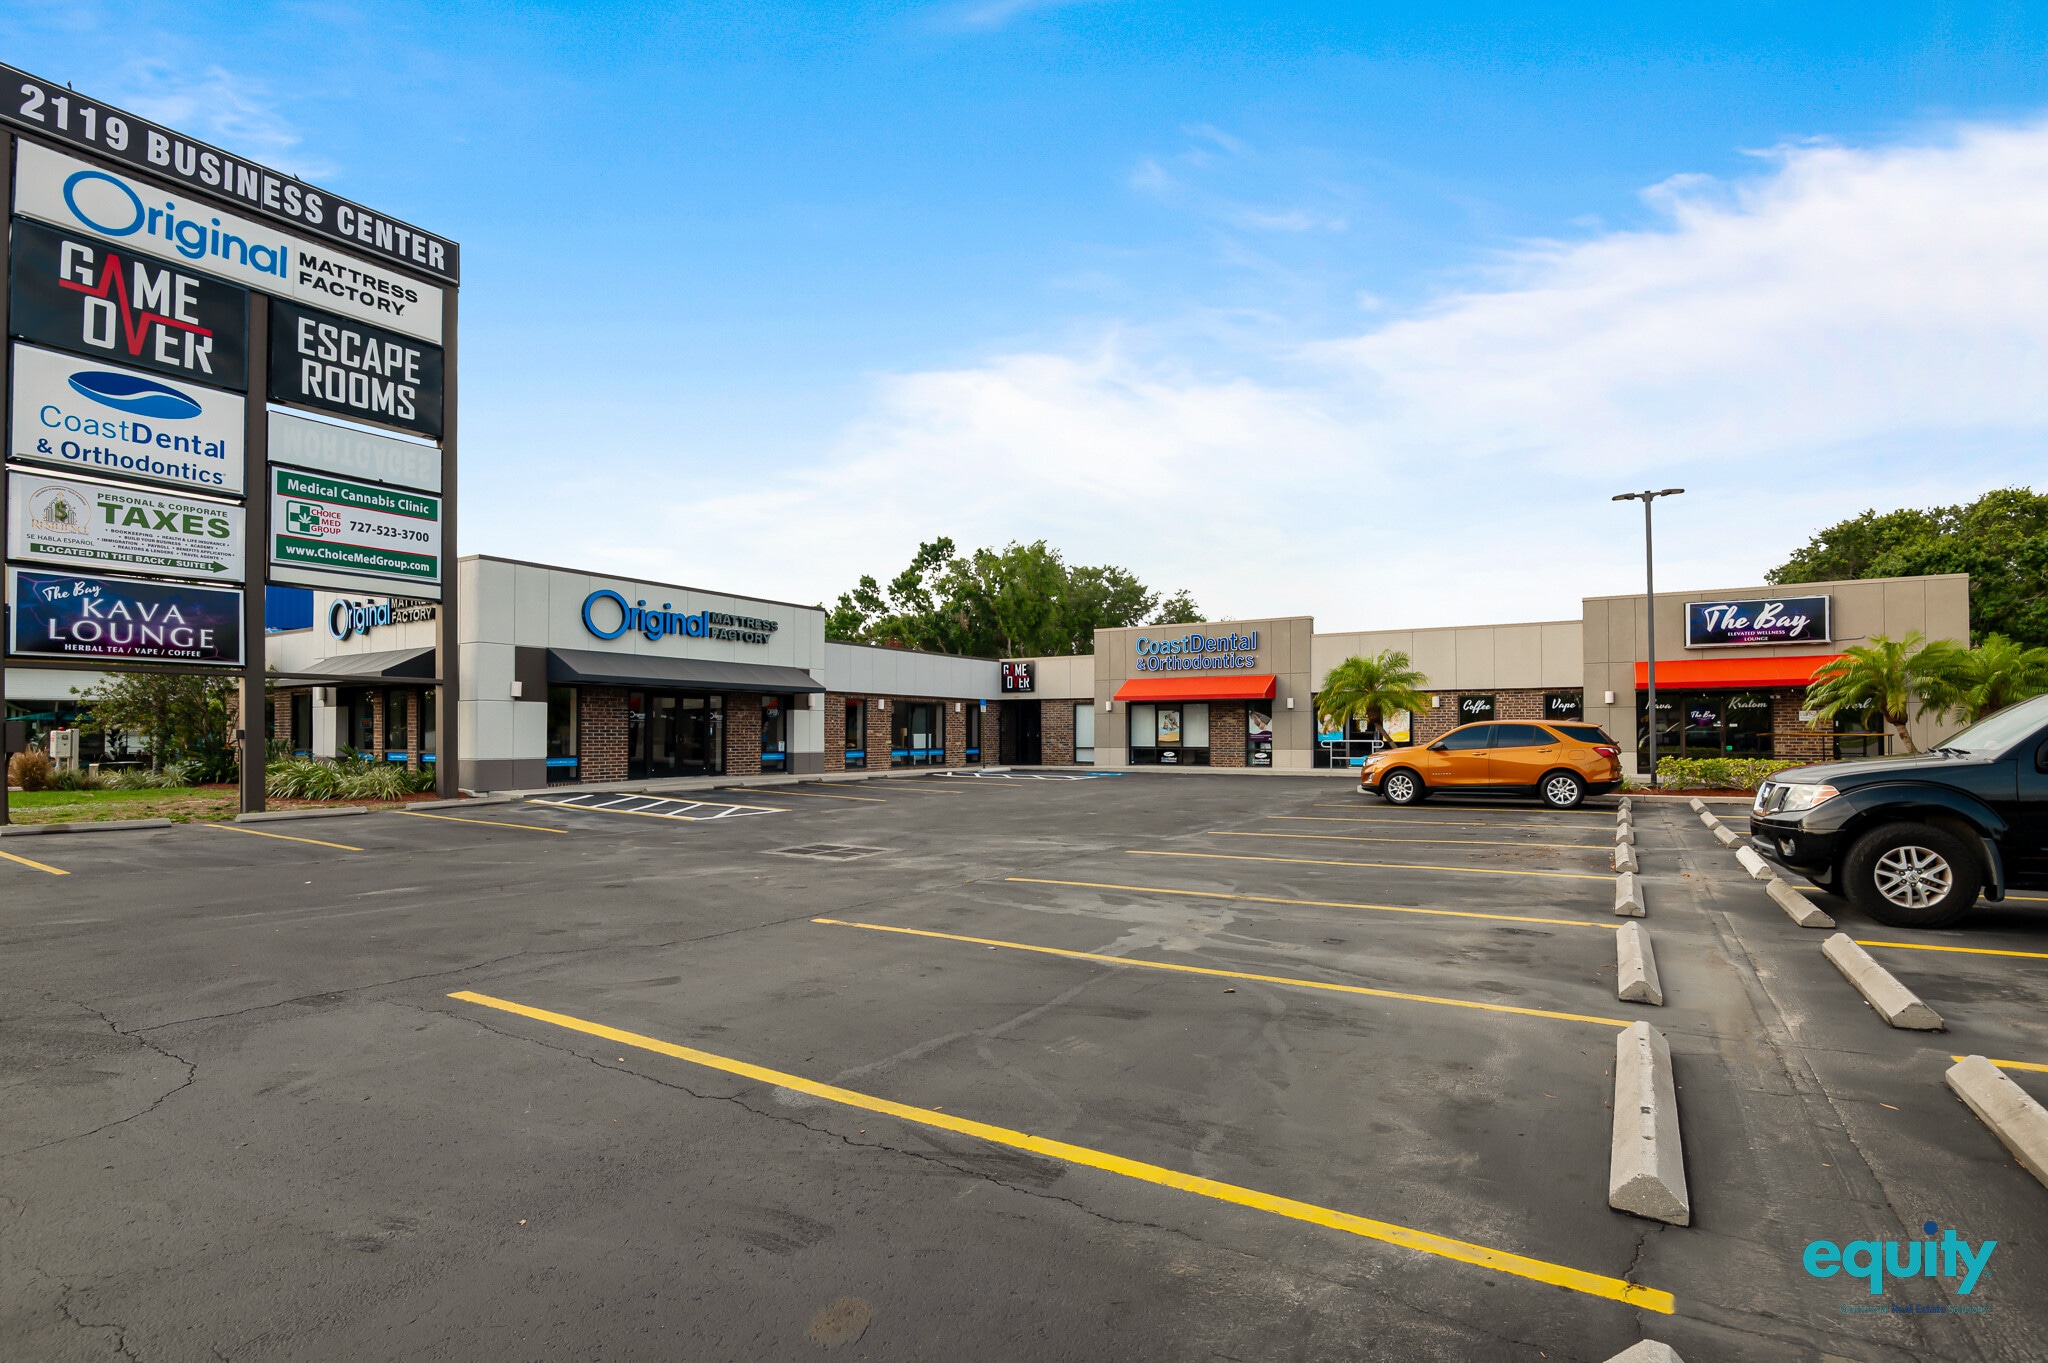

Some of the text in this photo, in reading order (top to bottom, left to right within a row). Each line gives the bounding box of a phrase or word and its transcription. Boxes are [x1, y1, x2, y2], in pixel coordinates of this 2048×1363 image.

[20, 84, 446, 271] 2119 BUSINESS CENTER
[63, 170, 288, 279] Original
[60, 240, 200, 326] GAME
[299, 252, 419, 304] MATTRESS
[299, 271, 406, 317] FACTORY
[83, 295, 213, 374] OVER
[297, 316, 421, 385] ESCAPE
[301, 360, 416, 421] ROOMS
[39, 404, 225, 460] CoastDental
[36, 438, 224, 485] & Orthodontics
[97, 493, 155, 508] PERSONAL
[157, 501, 166, 509] &
[168, 503, 228, 518] CORPORATE
[287, 479, 429, 514] Medical Cannabis Clinic
[97, 502, 230, 539] TAXES
[311, 508, 342, 519] CHOICE
[321, 518, 341, 527] MED
[37, 535, 62, 543] HABLA
[63, 537, 94, 546] ESPAÑOL
[101, 537, 138, 545] IMMIGRATION
[110, 528, 153, 538] BOOKKEEPING
[311, 525, 341, 535] GROUP
[350, 520, 430, 543] 727-523-3700
[39, 545, 94, 558] LOCATED
[96, 551, 108, 559] IN
[111, 552, 133, 561] THE
[136, 556, 165, 565] BACK
[176, 559, 205, 569] SUITE
[286, 545, 430, 571] www.ChoiceMedGroup.com
[42, 581, 102, 601] The Bay
[83, 597, 186, 624] KAVA
[328, 598, 391, 641] Original
[391, 608, 433, 623] FACTORY
[581, 589, 709, 641] Original
[710, 612, 779, 632] MATTRESS
[1704, 602, 1810, 637] The Bay
[49, 618, 214, 649] LOUNGE
[710, 627, 772, 644] FACTORY
[1136, 630, 1257, 655] CoastDental
[64, 643, 103, 652] HERBAL
[135, 647, 159, 655] VAPE
[168, 648, 201, 657] COFFEE
[1136, 652, 1255, 671] & Orthodontics
[1003, 663, 1028, 677] GAME
[1007, 676, 1030, 689] OVER
[1463, 699, 1491, 713] Coffee
[1551, 698, 1576, 712] Vape
[1691, 710, 1716, 720] The Bay
[1728, 697, 1768, 710] Kratom
